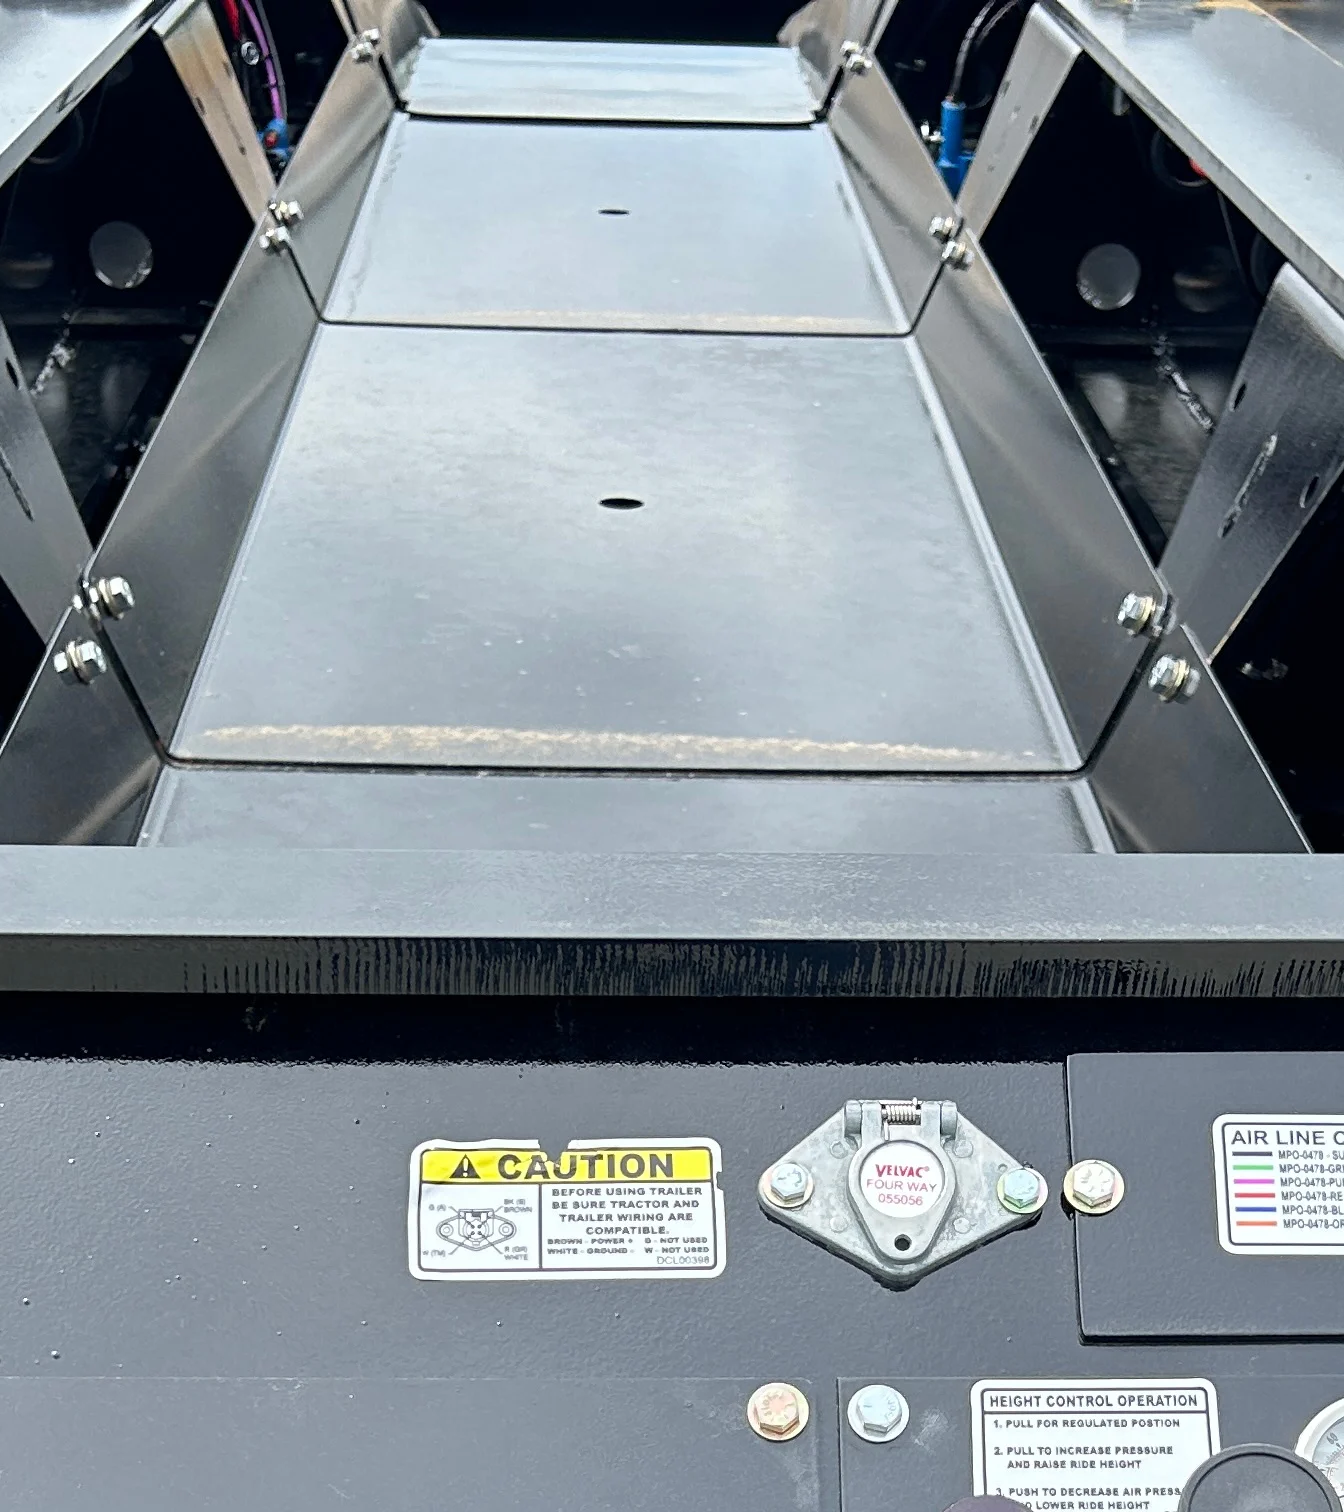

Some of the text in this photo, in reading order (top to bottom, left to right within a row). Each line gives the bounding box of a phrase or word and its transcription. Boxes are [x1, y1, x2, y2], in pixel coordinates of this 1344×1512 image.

[1231, 1130, 1268, 1145] AIR
[1276, 1131, 1325, 1145] LINE
[1278, 1150, 1324, 1160] MPO-0478
[498, 1153, 673, 1180] CAUTION
[867, 1179, 937, 1192] FOUR WAY
[551, 1187, 702, 1197] BEFORE USING TRAILER
[551, 1200, 699, 1210] BE SURE TRACTOR AND
[878, 1194, 923, 1206] 055056
[559, 1212, 693, 1222] TRAILER WIRING ARE
[585, 1226, 670, 1235] COMPATIBLE.
[990, 1395, 1197, 1407] HEIGHT CONTROL OPERATION
[1006, 1419, 1180, 1428] PULL FOR REGULATED POSTION
[1327, 1432, 1339, 1445] 60
[1007, 1446, 1173, 1455] PULL TO INCREASE PRESSURE
[1070, 1460, 1096, 1468] RIDE
[1100, 1460, 1142, 1468] HEIGHT
[1009, 1488, 1142, 1496] PUSH TO DECREASE AIR
[1036, 1502, 1074, 1510] LOWER
[1108, 1501, 1150, 1509] HEIGHT
